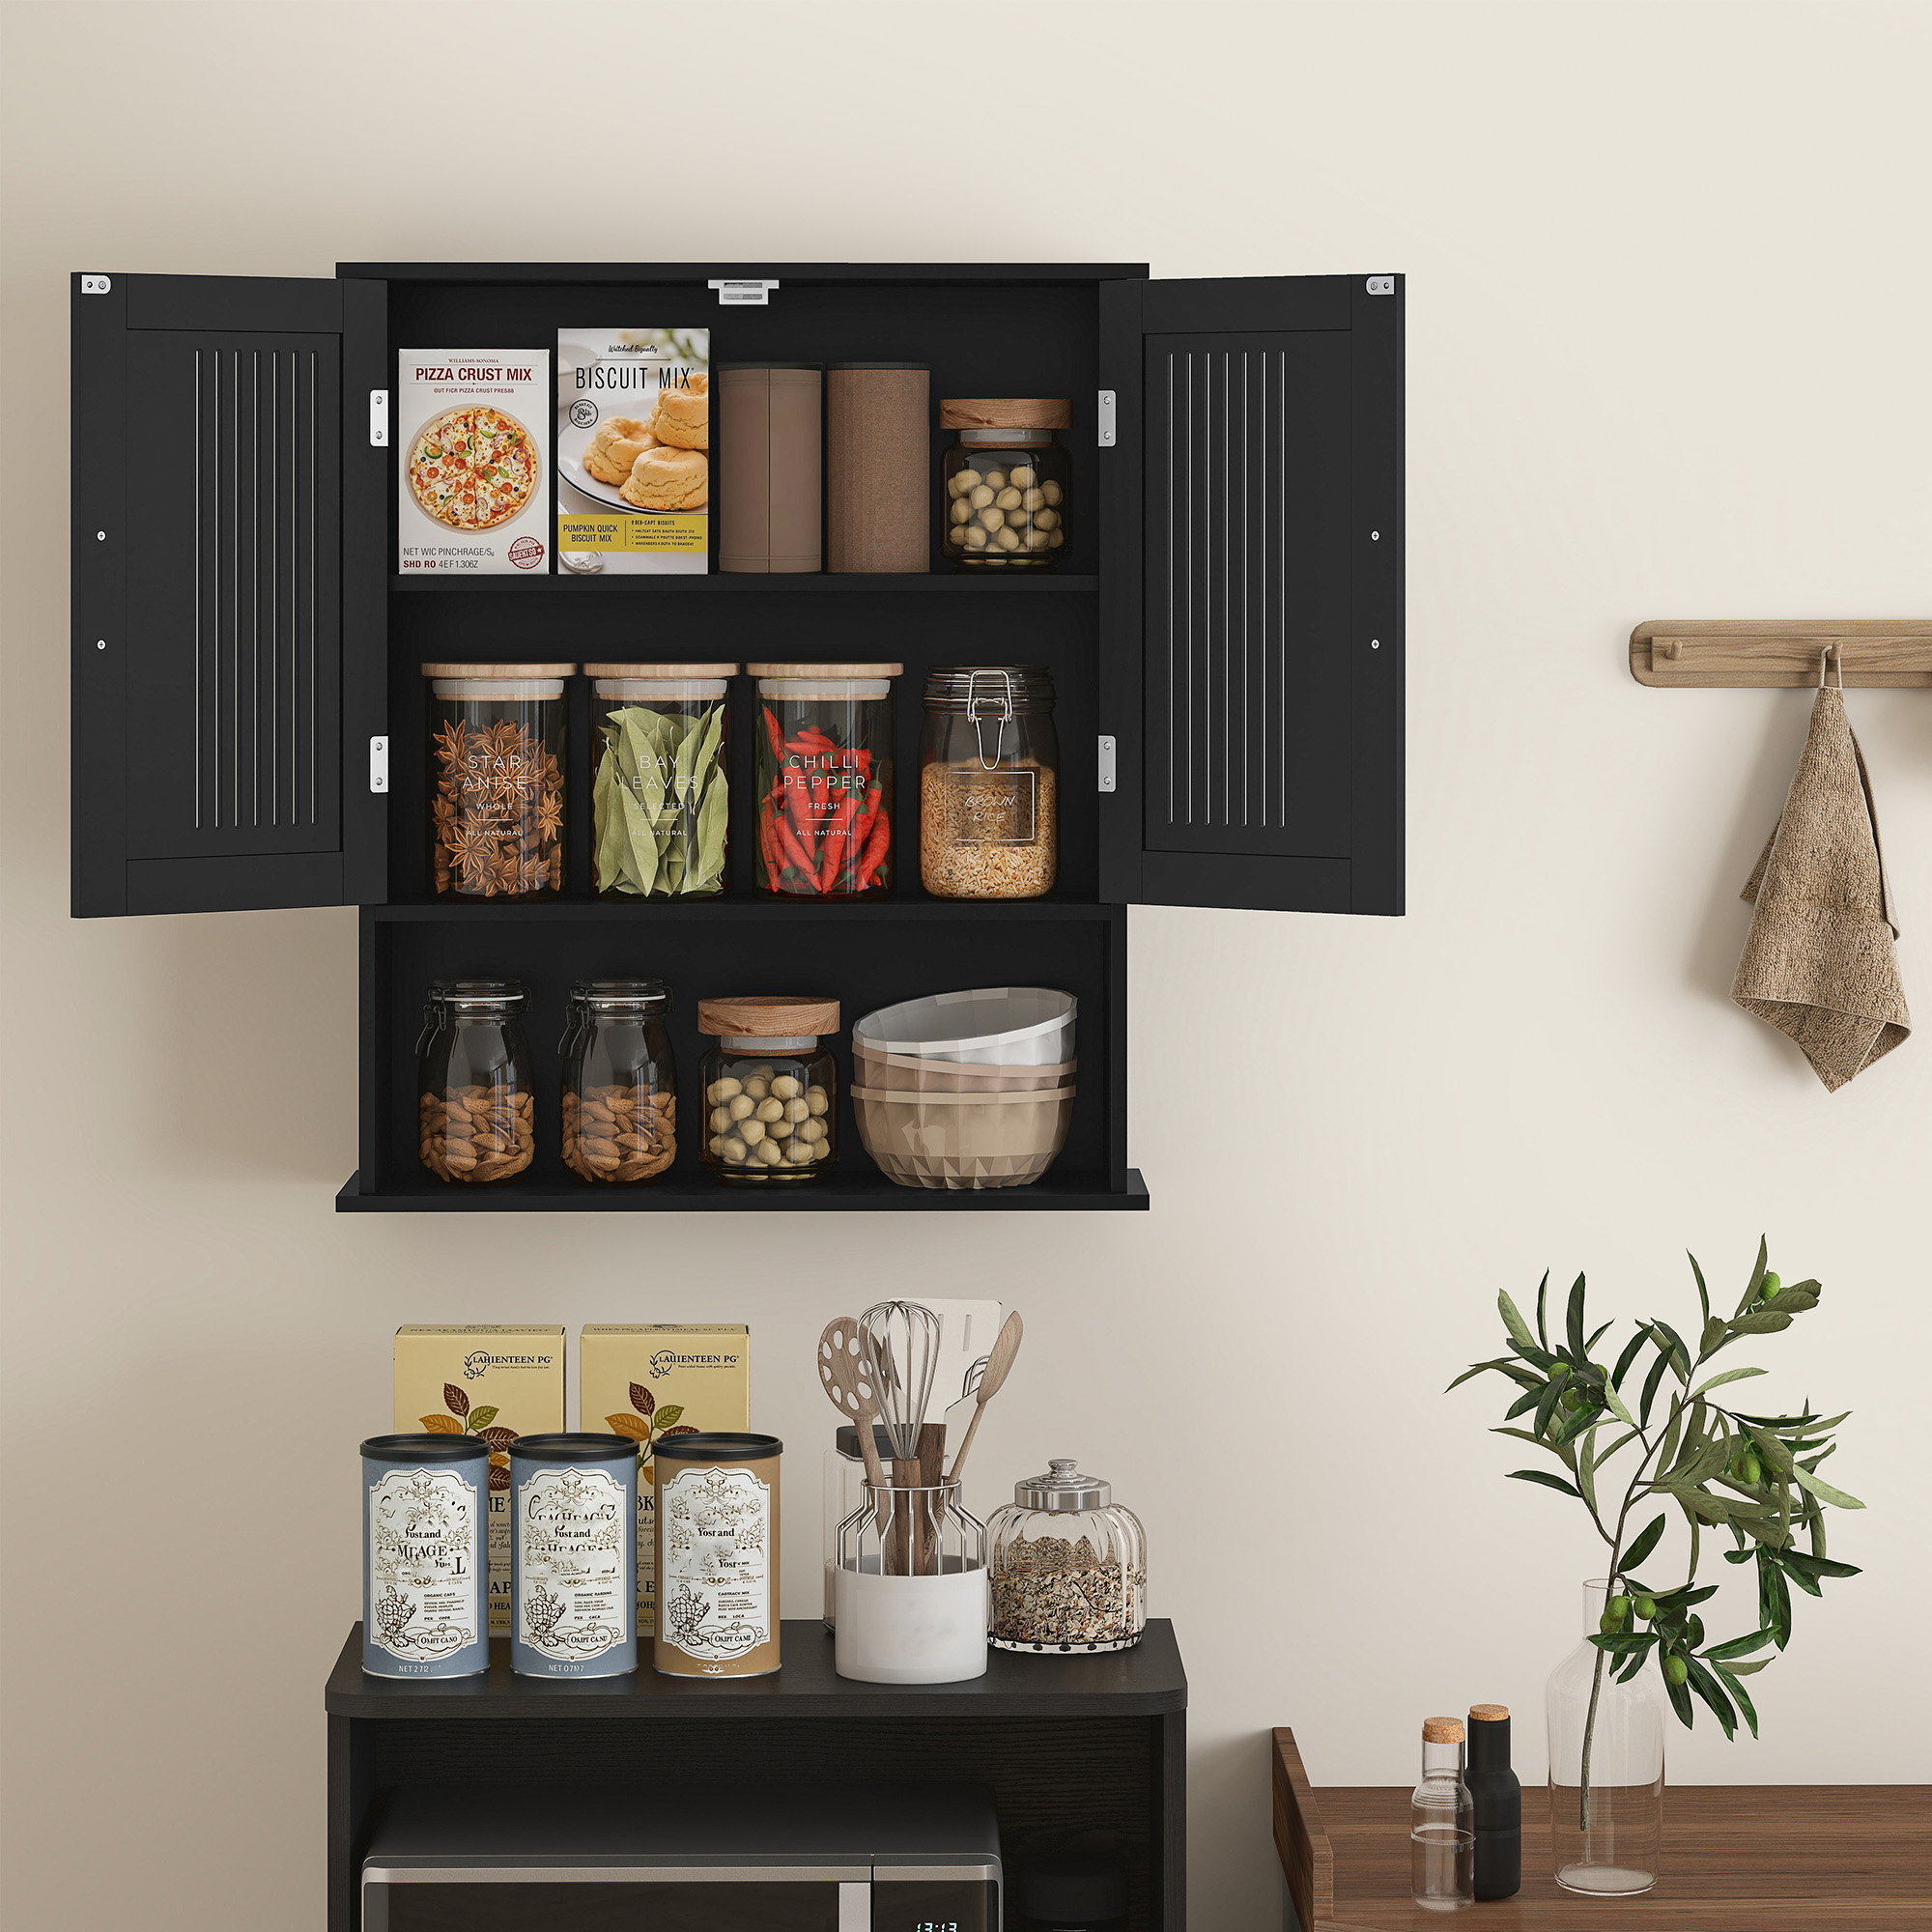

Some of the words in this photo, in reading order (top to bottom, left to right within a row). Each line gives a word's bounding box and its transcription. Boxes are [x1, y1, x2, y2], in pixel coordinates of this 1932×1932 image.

[415, 367, 454, 381] PIZZA
[458, 367, 502, 381] CRUST
[506, 368, 532, 381] MIX
[576, 367, 648, 389] BISCUIT
[659, 367, 691, 389] MIX
[563, 525, 595, 533] PUMPKIN
[597, 525, 618, 533] QUICK
[572, 534, 597, 543] BISCUIT
[599, 534, 612, 543] MIX
[403, 548, 418, 556] NET
[420, 548, 437, 556] WIC
[469, 755, 521, 769] STAR
[639, 755, 681, 769] BAY
[789, 755, 860, 769] CHILLI
[462, 776, 527, 790] ANISE
[621, 776, 699, 789] LEAVES
[783, 776, 867, 789] PEPPER
[964, 795, 1016, 808] BROWN
[973, 812, 1007, 822] RICE
[573, 1528, 591, 1538] and
[717, 1527, 735, 1537] and
[398, 1664, 412, 1673] NET
